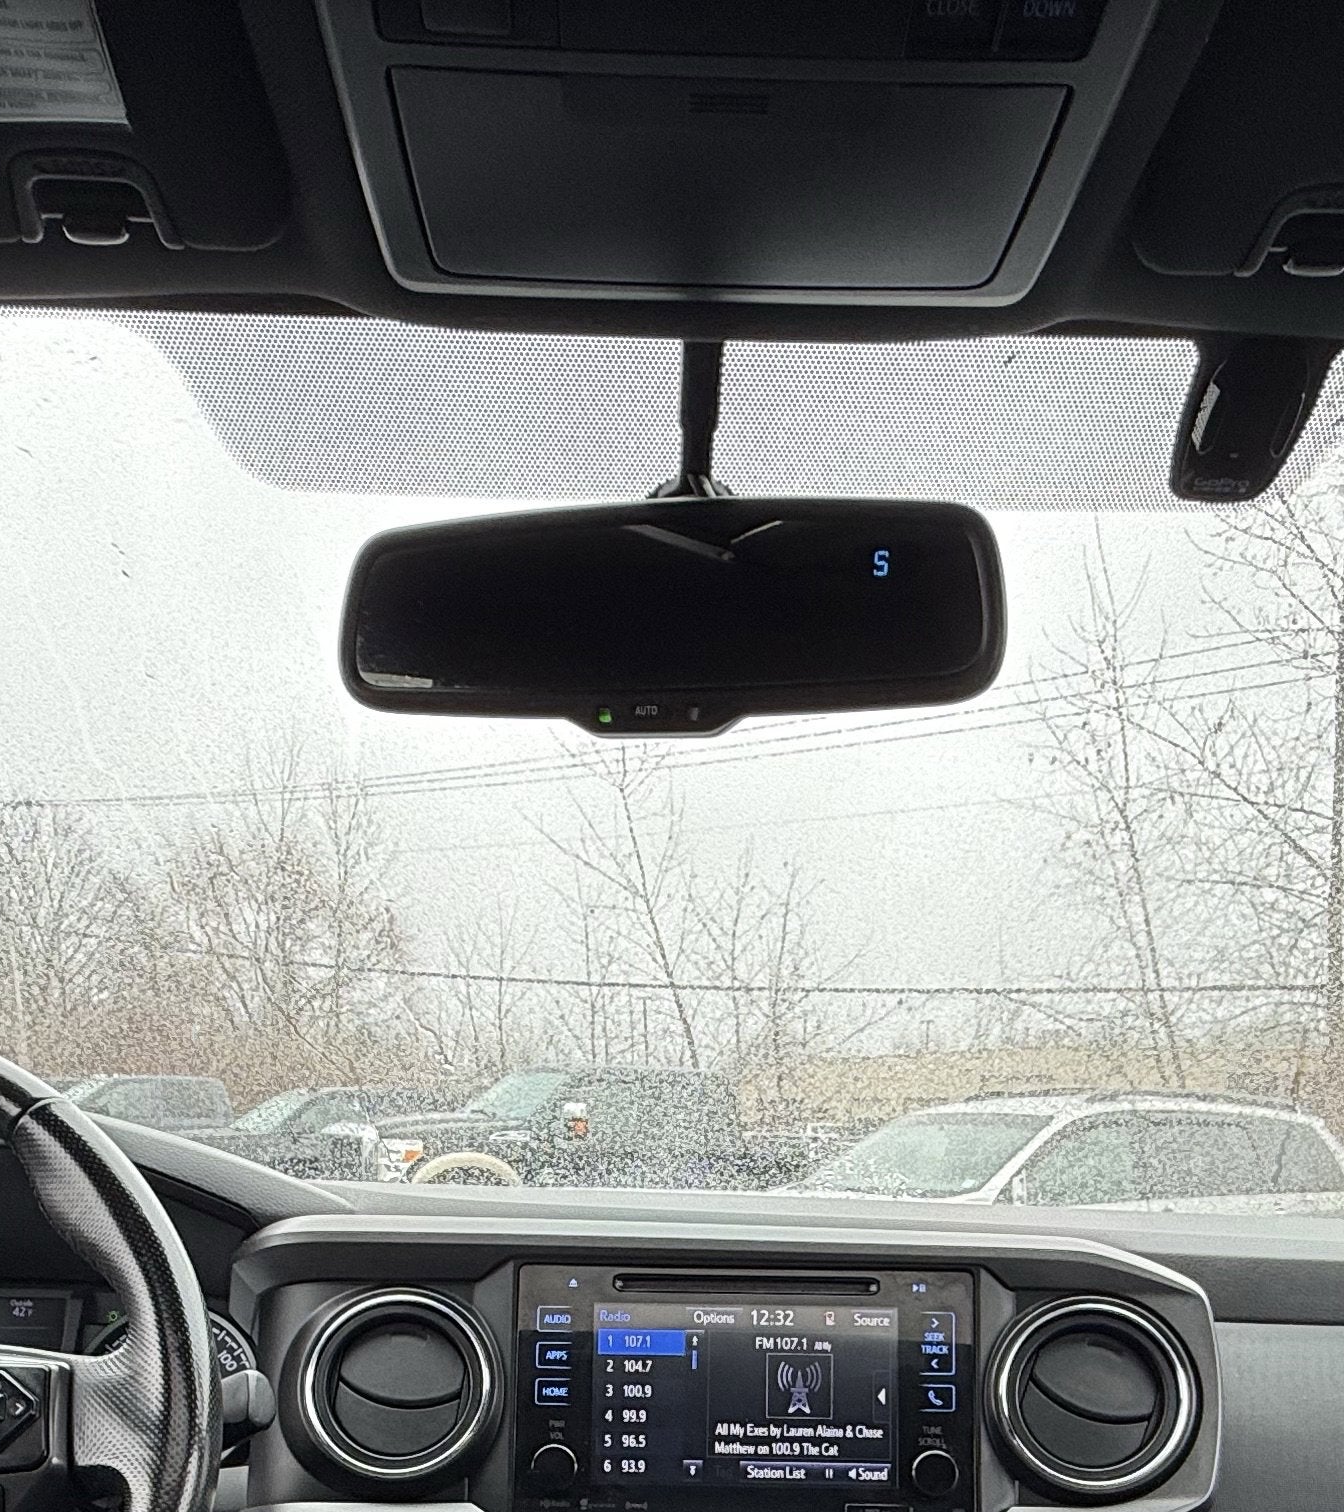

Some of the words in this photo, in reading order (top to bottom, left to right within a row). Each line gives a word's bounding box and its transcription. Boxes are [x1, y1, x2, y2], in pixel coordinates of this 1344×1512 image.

[873, 550, 890, 577] S
[635, 705, 659, 716] AUTO
[544, 1314, 571, 1324] AUDIO
[599, 1310, 631, 1322] Radio
[693, 1310, 735, 1327] Options
[750, 1309, 794, 1327] 12:32
[853, 1313, 891, 1327] Source
[607, 1334, 613, 1347] 1
[624, 1335, 651, 1347] 107.1
[923, 1332, 945, 1342] SEEK
[545, 1350, 568, 1360] APPS
[921, 1344, 949, 1354] TRACK
[217, 1350, 237, 1371] 100
[606, 1359, 614, 1372] 2
[623, 1360, 653, 1372] 104.7
[543, 1387, 569, 1397] HOME
[605, 1384, 613, 1397] 3
[623, 1385, 652, 1397] 100.9
[604, 1409, 613, 1422] 4
[622, 1409, 646, 1423] 99.9
[549, 1431, 564, 1440] VOL
[715, 1423, 728, 1436] All
[729, 1423, 744, 1438] My
[746, 1424, 768, 1436] Exes
[769, 1424, 782, 1439] by
[783, 1424, 814, 1437] Lauren
[845, 1425, 853, 1438] &
[855, 1425, 884, 1438] Chase
[603, 1434, 612, 1447] 5
[621, 1435, 646, 1448] 96.5
[714, 1441, 755, 1454] Matthew
[757, 1445, 769, 1454] on
[771, 1442, 800, 1455] 100.9
[801, 1442, 819, 1456] The
[821, 1443, 839, 1456] Cat
[603, 1460, 611, 1472] 6
[621, 1460, 646, 1473] 93.9
[746, 1465, 784, 1479] Station
[785, 1466, 806, 1479] List
[857, 1467, 888, 1481] Sound
